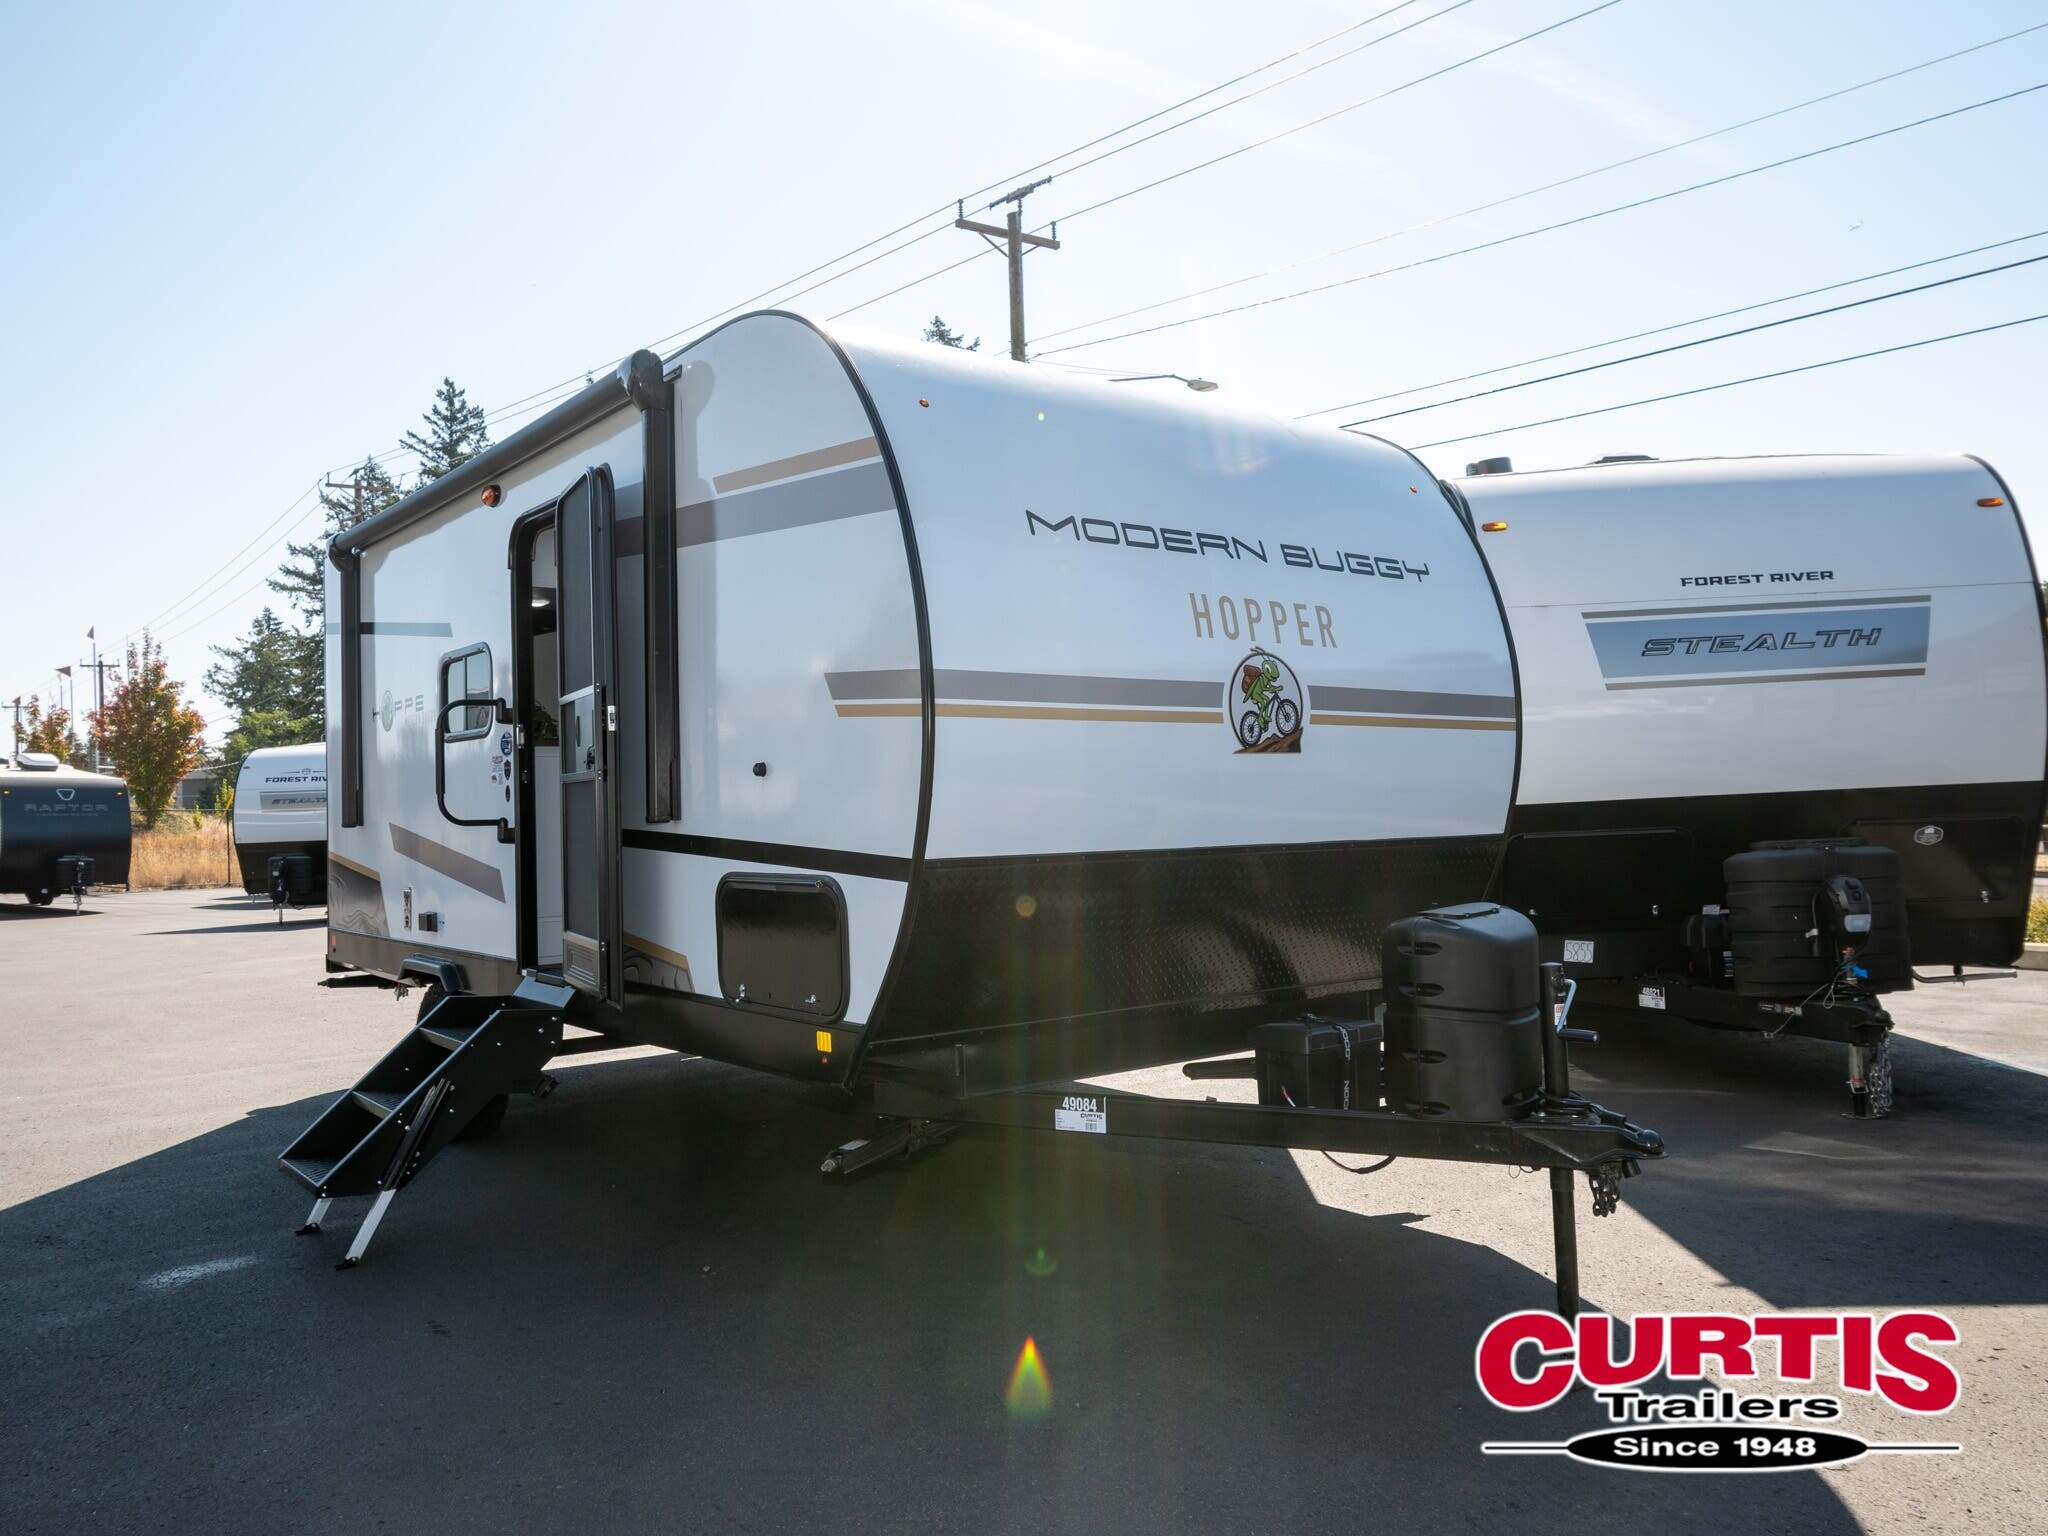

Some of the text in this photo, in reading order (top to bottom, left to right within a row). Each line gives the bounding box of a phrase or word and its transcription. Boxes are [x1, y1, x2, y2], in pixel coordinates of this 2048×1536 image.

[1025, 509, 1430, 582] MODERN BUGGY
[1680, 570, 1835, 587] FOREST RIVER
[1189, 592, 1338, 648] HOPPER
[1641, 628, 1883, 657] STEALTH
[265, 776, 308, 784] FOREST
[23, 803, 109, 812] RAPTOR
[1062, 1096, 1097, 1112] 49084
